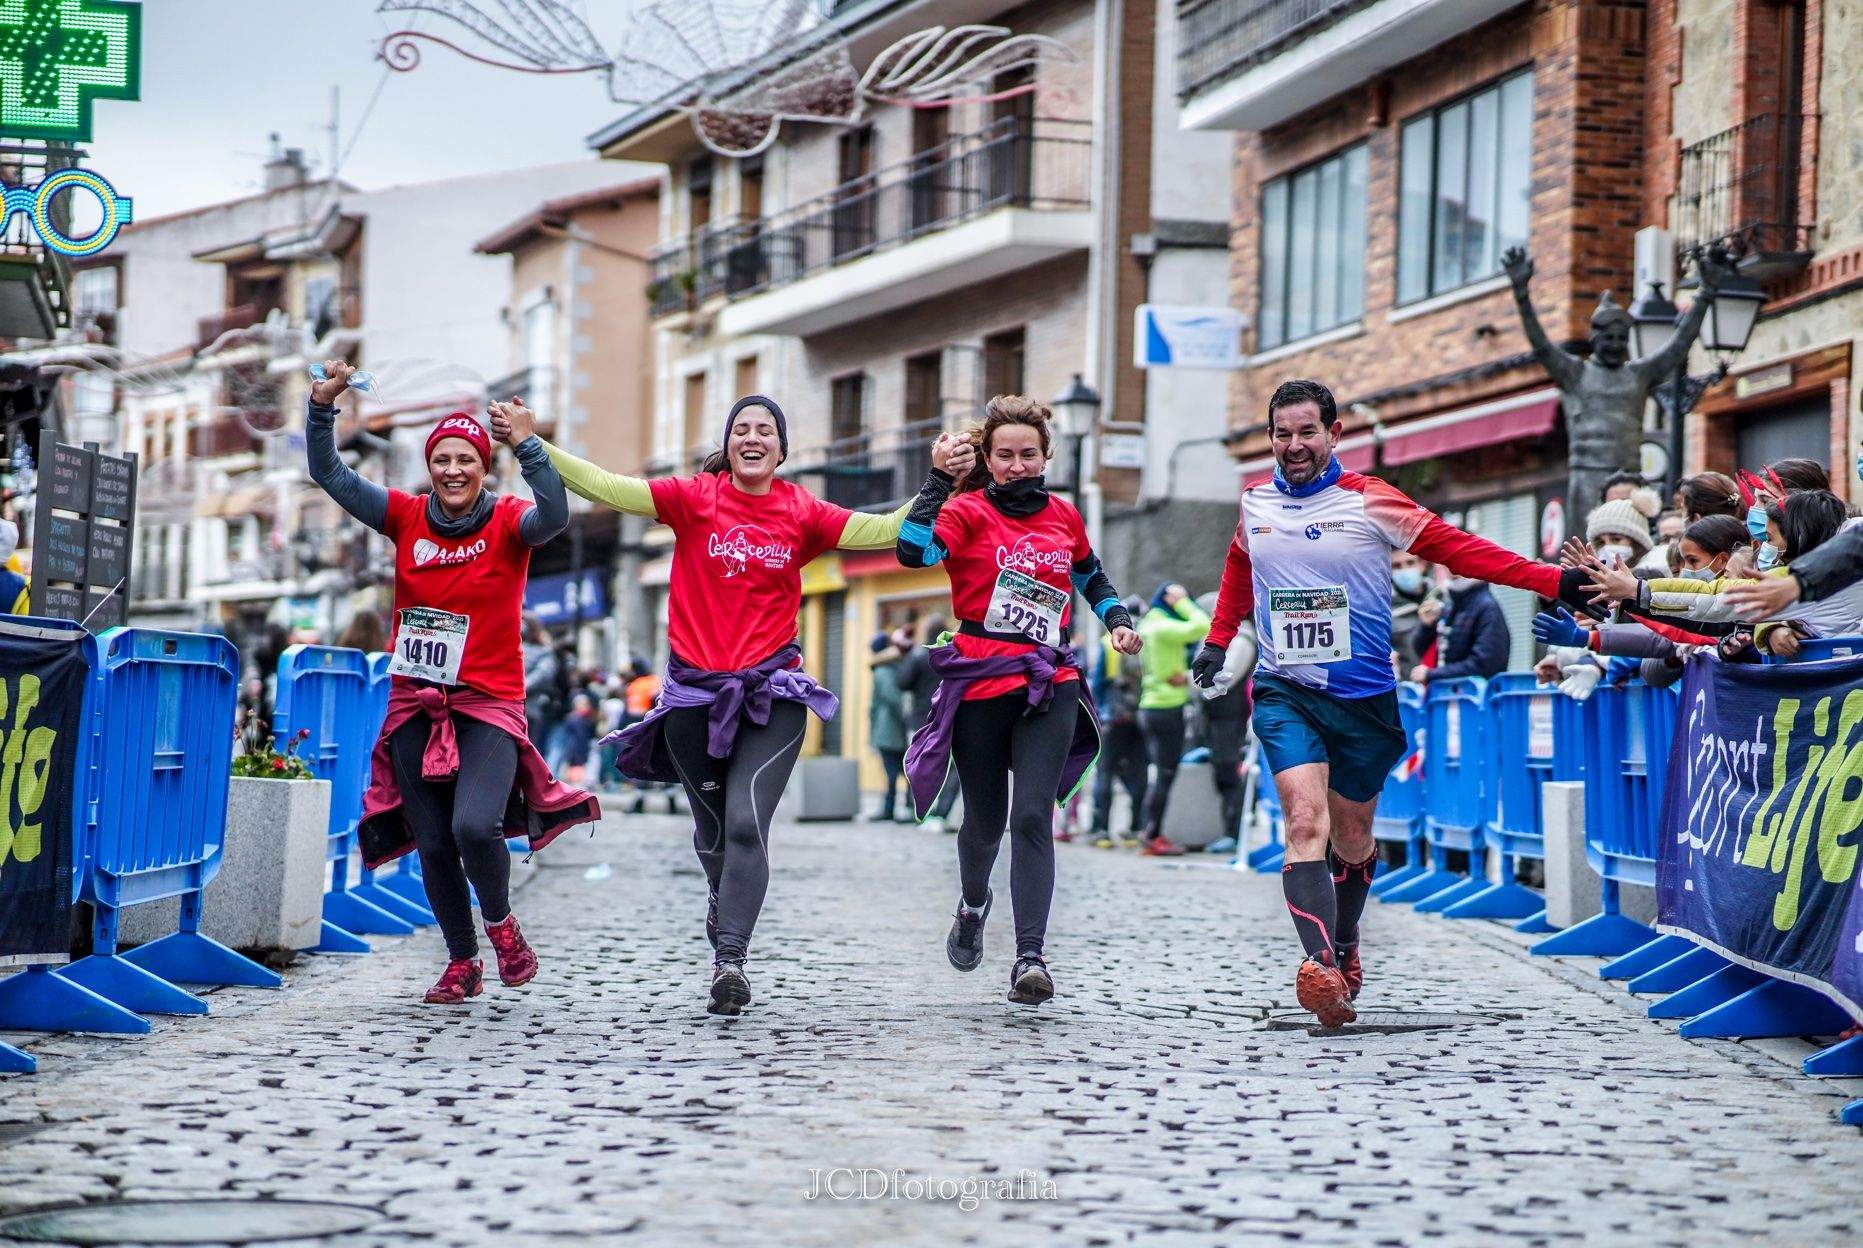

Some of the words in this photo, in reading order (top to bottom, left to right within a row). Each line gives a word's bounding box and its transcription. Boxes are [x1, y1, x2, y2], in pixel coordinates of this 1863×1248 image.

[1302, 591, 1329, 599] NAVIDAD
[1002, 603, 1048, 642] 1225
[1283, 621, 1334, 649] 1175
[403, 637, 448, 668] 1410
